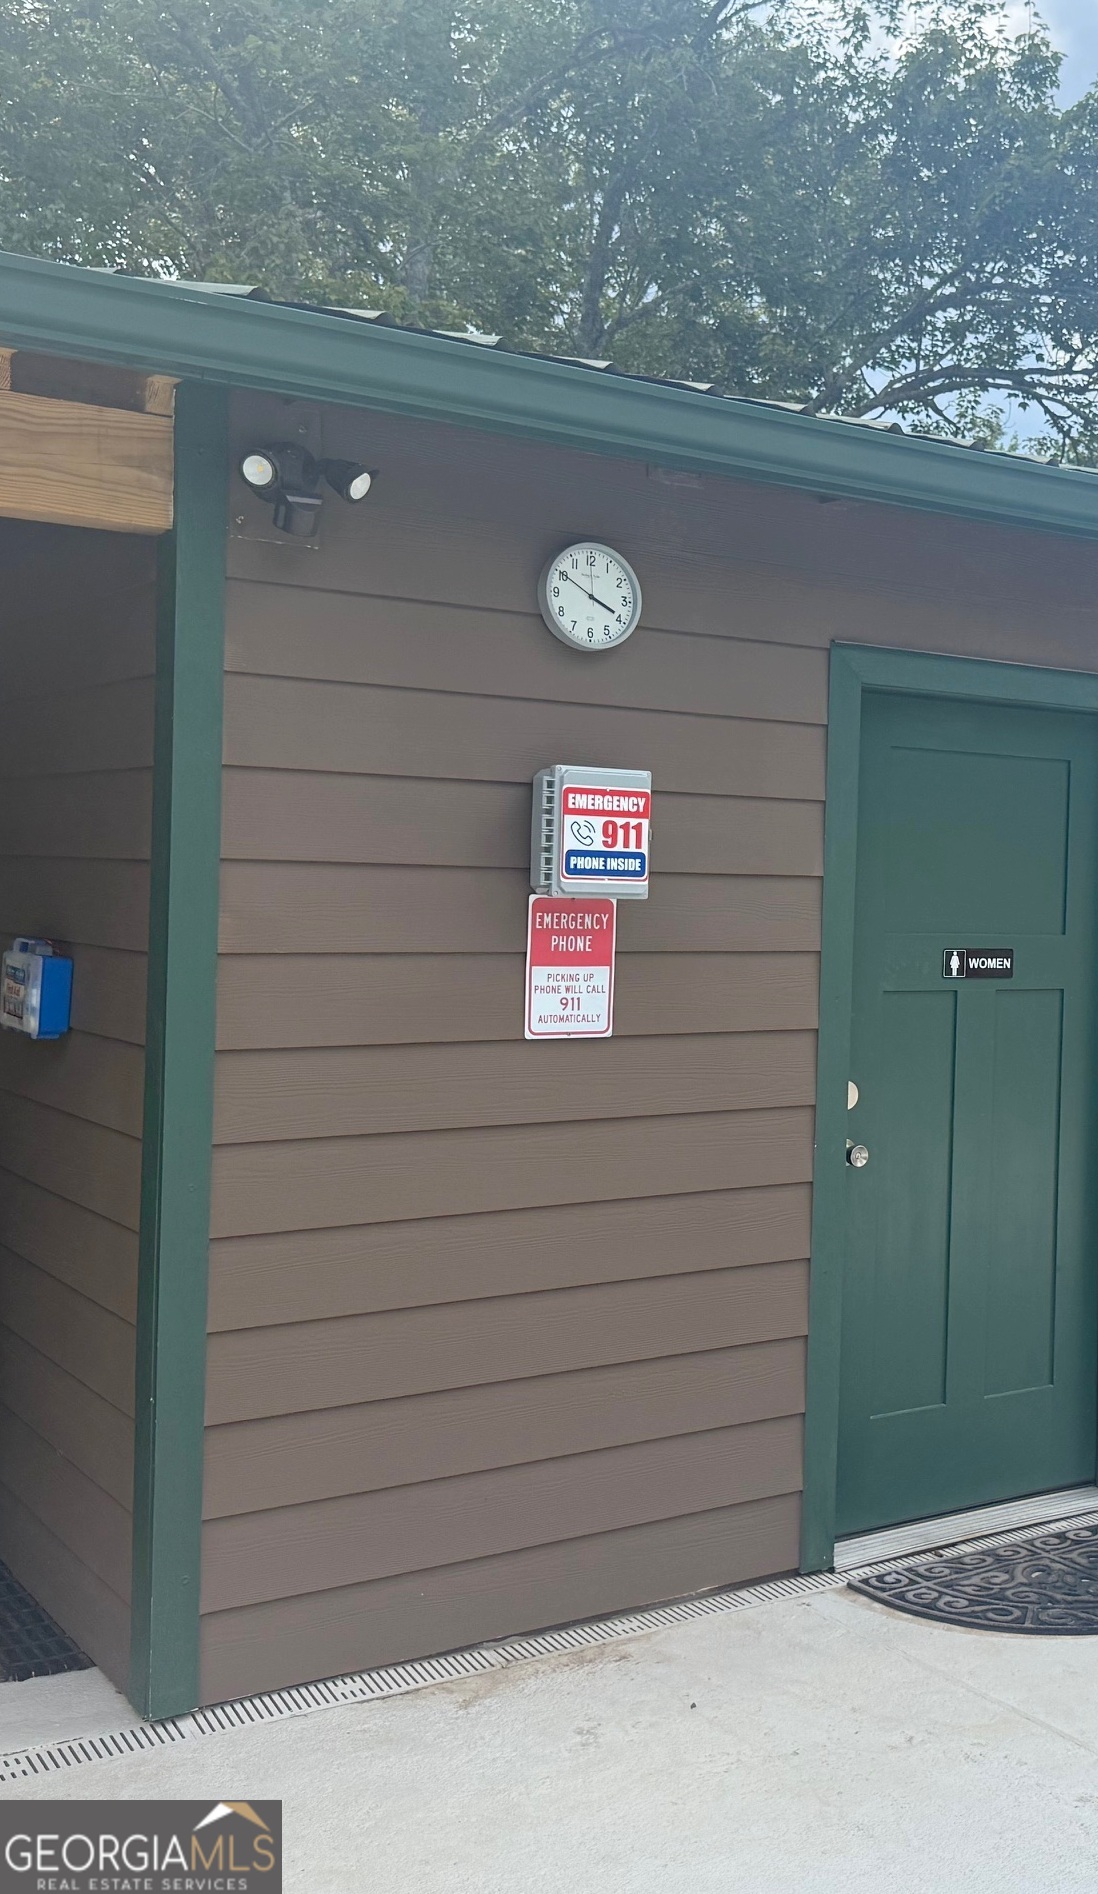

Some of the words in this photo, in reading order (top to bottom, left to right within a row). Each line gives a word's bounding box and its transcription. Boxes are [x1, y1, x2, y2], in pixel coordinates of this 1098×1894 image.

[572, 558, 578, 570] 11
[586, 554, 596, 566] 12
[558, 570, 568, 581] 10
[616, 578, 622, 588] 2
[553, 586, 560, 598] 9
[621, 596, 628, 607] 3
[558, 606, 564, 617] 8
[616, 614, 622, 624] 4
[571, 620, 577, 631] 7
[604, 625, 610, 636] 5
[587, 627, 594, 638] 6
[568, 792, 646, 812] EMERGENCY
[602, 819, 643, 849] 911
[569, 856, 605, 870] PHONE
[606, 857, 641, 872] INSIDE
[535, 912, 609, 930] EMERGENCY
[551, 935, 592, 952] PHONE
[968, 958, 1011, 968] WOMEN
[547, 973, 581, 983] PICKING
[583, 974, 594, 983] UP
[534, 985, 562, 994] PHONE
[565, 985, 584, 994] WILL
[587, 984, 606, 994] CALL
[559, 997, 581, 1011] 911
[537, 1014, 601, 1024] AUTOMATICALLY
